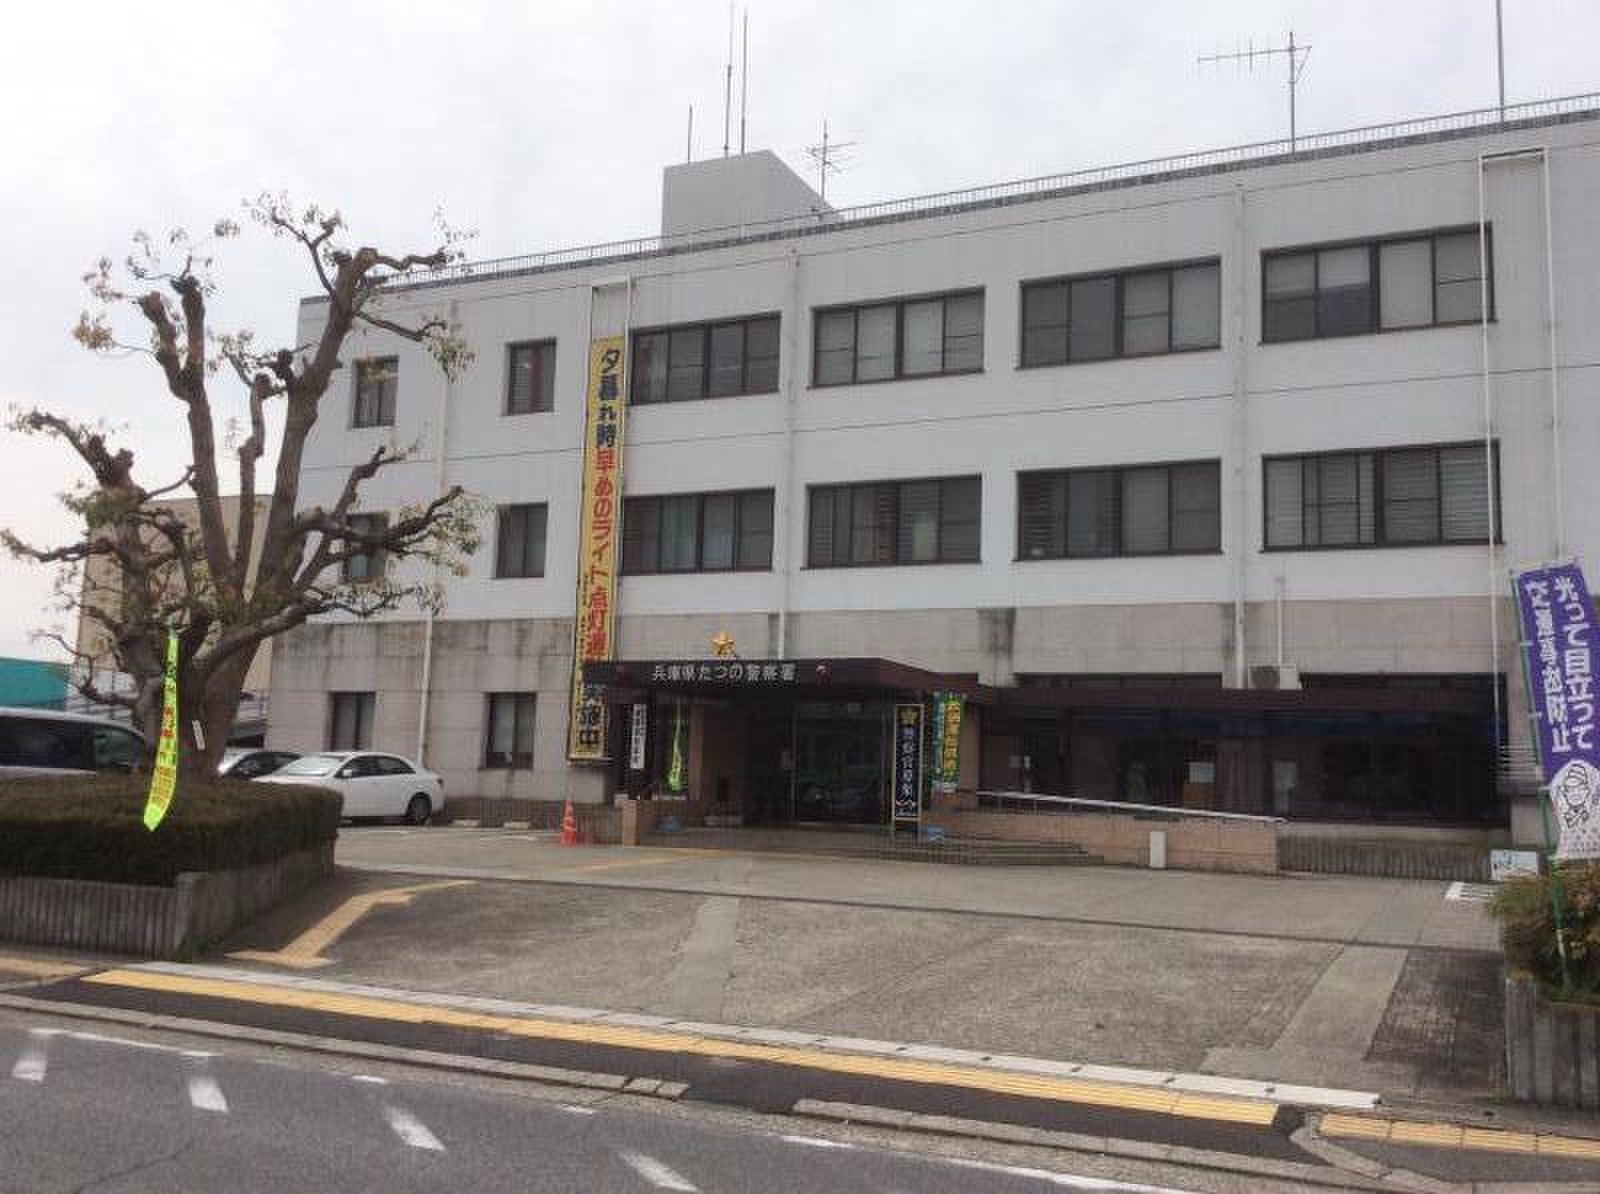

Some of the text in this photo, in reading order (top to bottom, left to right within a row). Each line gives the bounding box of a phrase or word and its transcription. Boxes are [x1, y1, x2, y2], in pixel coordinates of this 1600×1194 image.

[579, 350, 619, 745] 夕暮れ時早めのライト点灯運実施中
[653, 664, 797, 682] 兵庫県たつの警察署
[1526, 579, 1572, 753] 交通事故防止
[1554, 576, 1595, 750] 光って目立って
